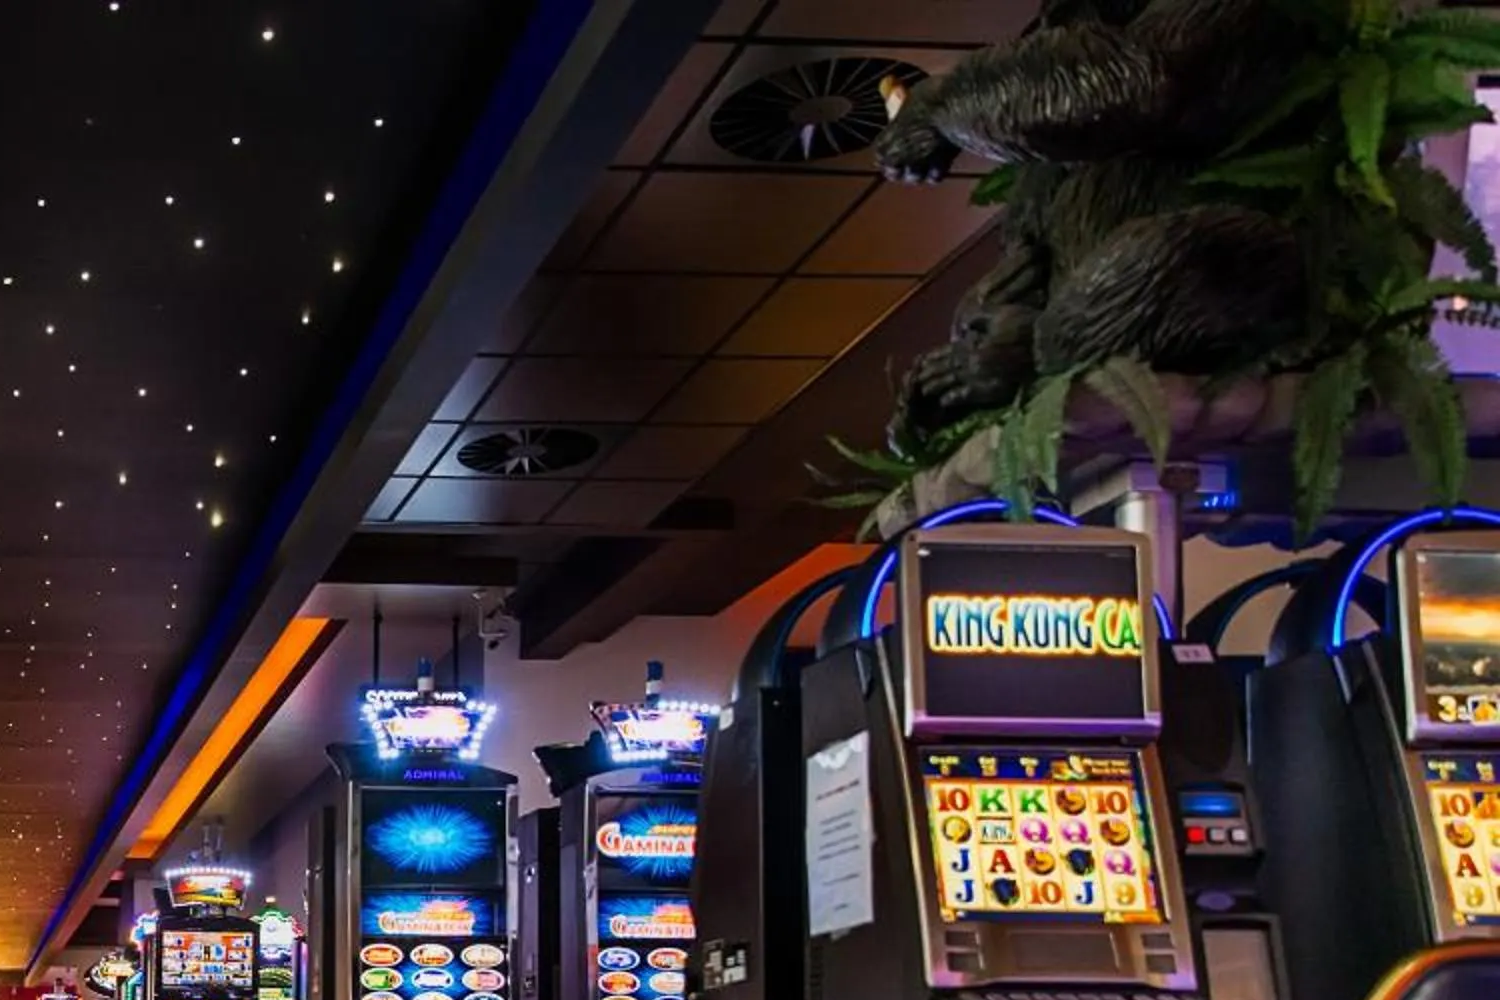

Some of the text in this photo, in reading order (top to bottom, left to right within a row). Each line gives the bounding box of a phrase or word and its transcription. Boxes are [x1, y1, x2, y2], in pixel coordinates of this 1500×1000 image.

[933, 600, 1142, 649] KING KONG CA
[403, 769, 465, 781] ADMIRAL
[936, 788, 1127, 814] 10 K K 10
[1438, 794, 1471, 817] 10
[597, 822, 695, 857] GAMINA
[1020, 818, 1052, 844] Q
[1062, 819, 1092, 844] Q
[951, 848, 1136, 876] J A Q
[1456, 854, 1482, 878] A
[955, 879, 974, 904] J
[1028, 881, 1063, 905] 10
[1076, 881, 1094, 905] J
